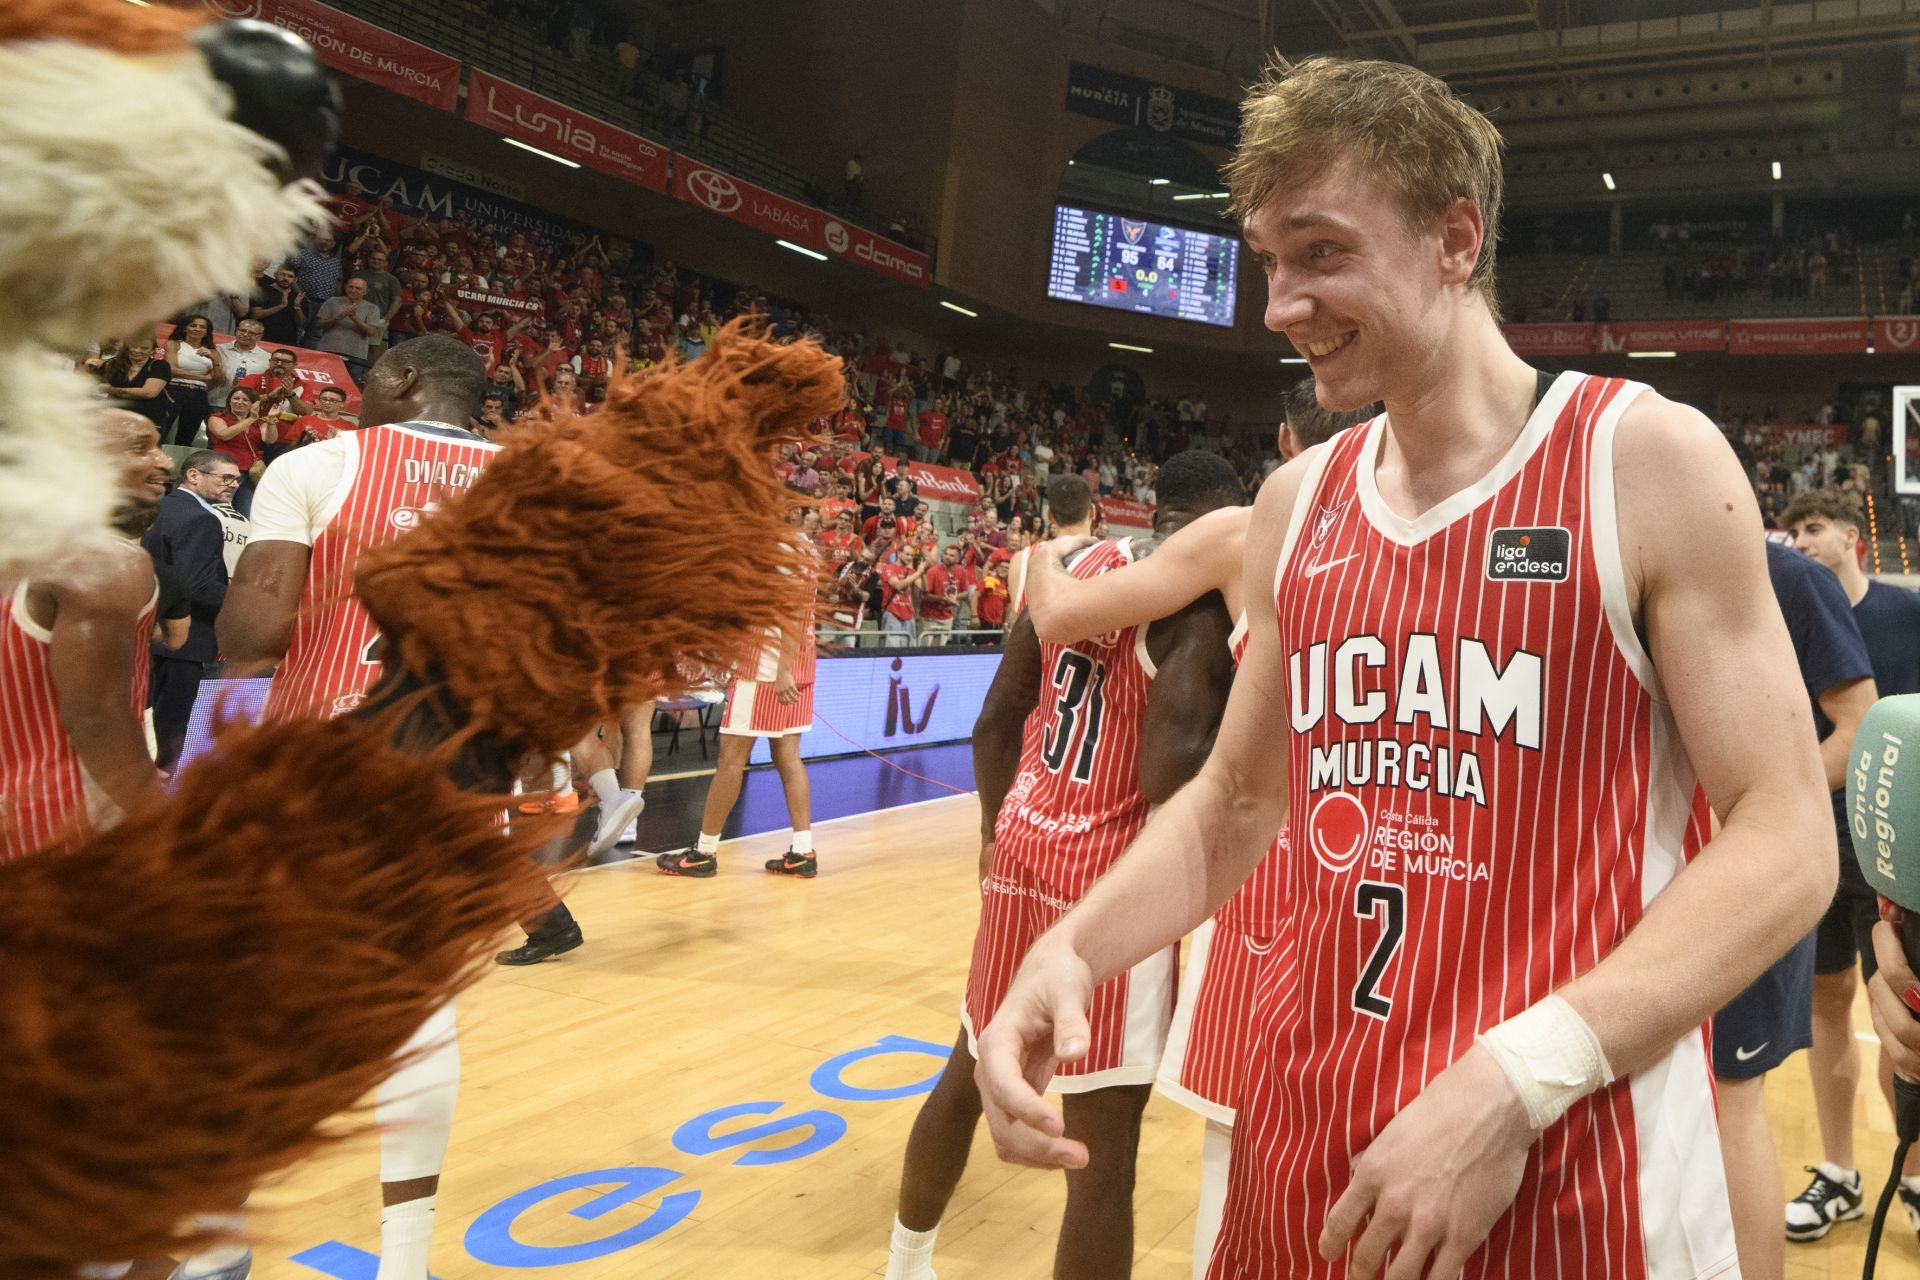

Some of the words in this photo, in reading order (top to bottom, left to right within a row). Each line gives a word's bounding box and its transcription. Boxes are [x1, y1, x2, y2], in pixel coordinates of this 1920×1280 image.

[273, 15, 346, 54] REGIÓN
[349, 46, 373, 65] DE
[378, 57, 442, 92] MURCIA
[320, 157, 454, 219] UCAM
[427, 157, 474, 181] Grada
[480, 175, 522, 197] Norte
[753, 200, 810, 233] LABASA
[855, 239, 923, 278] dama
[1121, 249, 1139, 265] 95
[1157, 256, 1175, 271] 64
[1135, 269, 1158, 283] 0.0
[457, 289, 486, 302] UCAM
[486, 294, 525, 310] MURCIA
[404, 458, 482, 489] DIAGN
[1495, 558, 1563, 575] endesa
[1496, 544, 1527, 561] liga
[1289, 632, 1543, 752] UCAM
[1041, 648, 1106, 785] 31
[1309, 738, 1488, 809] MURCIA
[1854, 750, 1873, 840] Onda
[1869, 732, 1904, 880] Regional
[1380, 808, 1403, 824] Costa
[1404, 812, 1439, 828] Cálida
[1373, 827, 1455, 855] REGIÓN
[1370, 849, 1397, 874] DE
[1404, 849, 1490, 882] MURCIA
[1351, 879, 1407, 1023] 2
